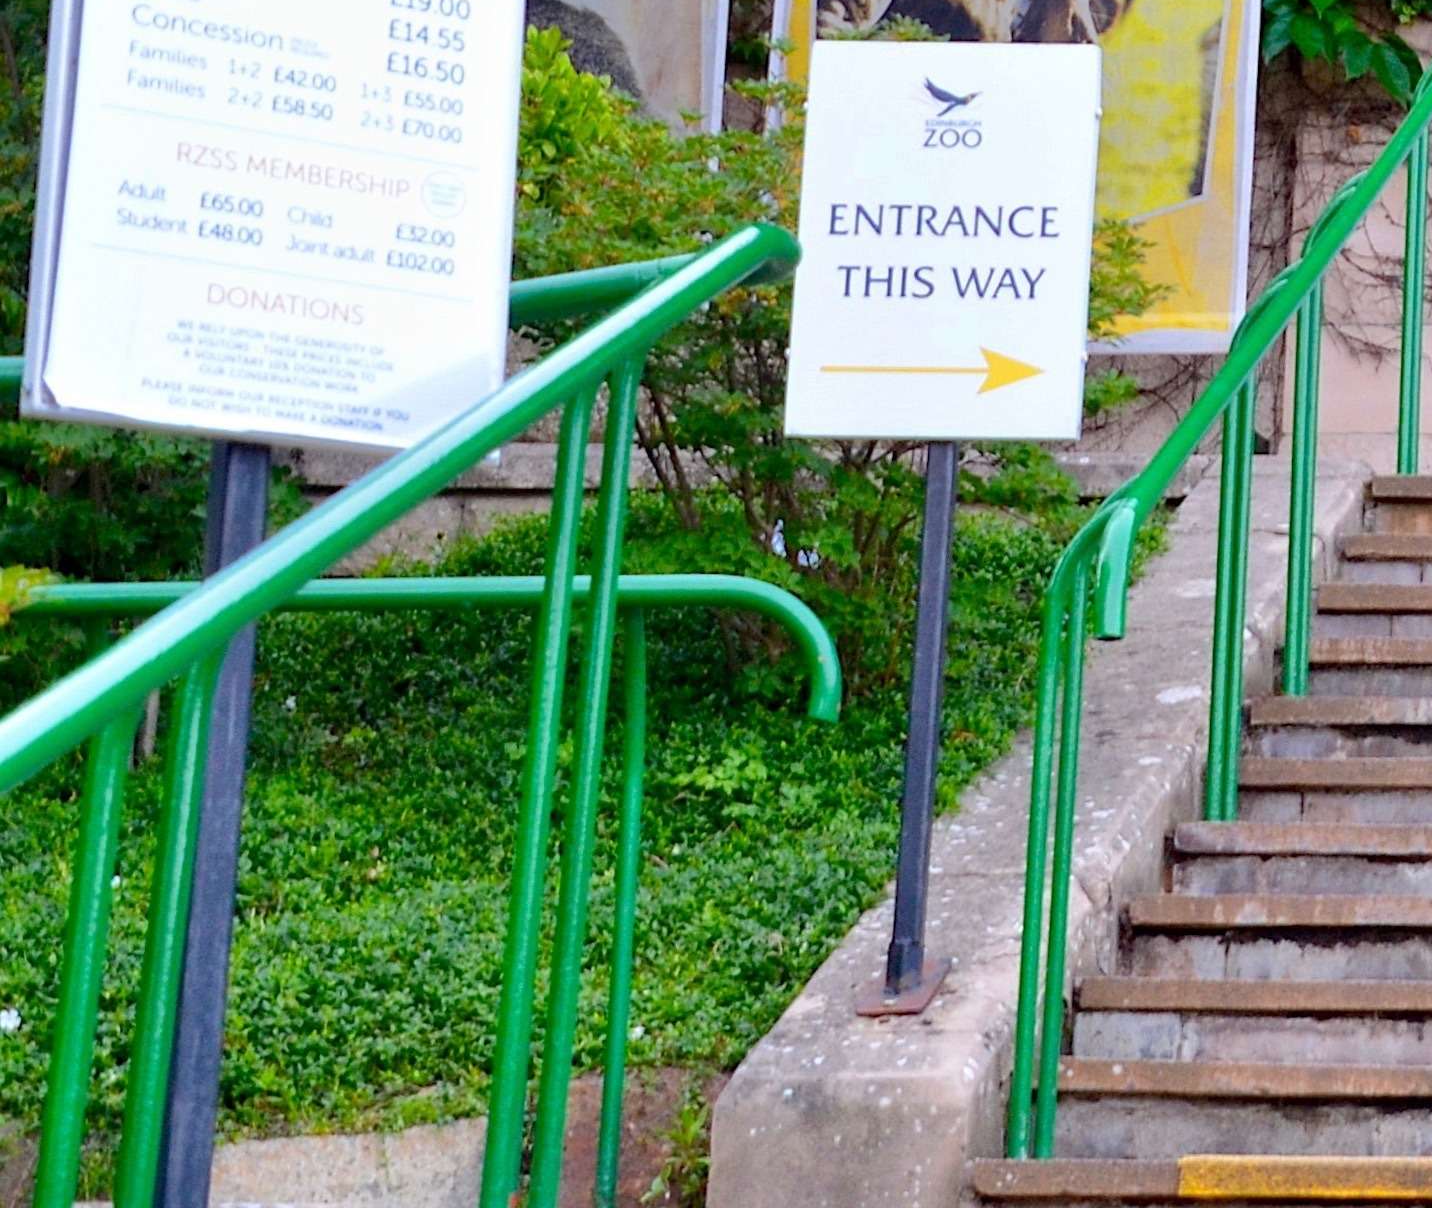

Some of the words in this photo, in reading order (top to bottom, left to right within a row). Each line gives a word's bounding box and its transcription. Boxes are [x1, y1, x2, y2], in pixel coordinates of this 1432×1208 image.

[132, 4, 284, 51] Concession
[387, 51, 465, 86] £16.50
[389, 18, 465, 52] £14.55
[129, 40, 207, 70] Families
[274, 66, 337, 93] £42.00
[404, 90, 464, 116] £55.00
[127, 68, 206, 99] Families
[272, 95, 333, 121] £58.50
[402, 118, 463, 144] £70.00
[923, 128, 982, 148] ZOO
[177, 142, 238, 171] RZSS
[246, 155, 410, 198] MEMBERSHIP
[118, 180, 166, 202] Adult
[200, 191, 264, 218] £65.00
[287, 205, 333, 229] Child
[828, 204, 1060, 239] ENTRANCE
[117, 208, 187, 234] Student
[198, 220, 263, 246] £48.00
[386, 250, 455, 276] £102.00
[207, 283, 364, 325] DONATIONS
[838, 266, 935, 299] THIS
[953, 267, 1046, 299] WAY
